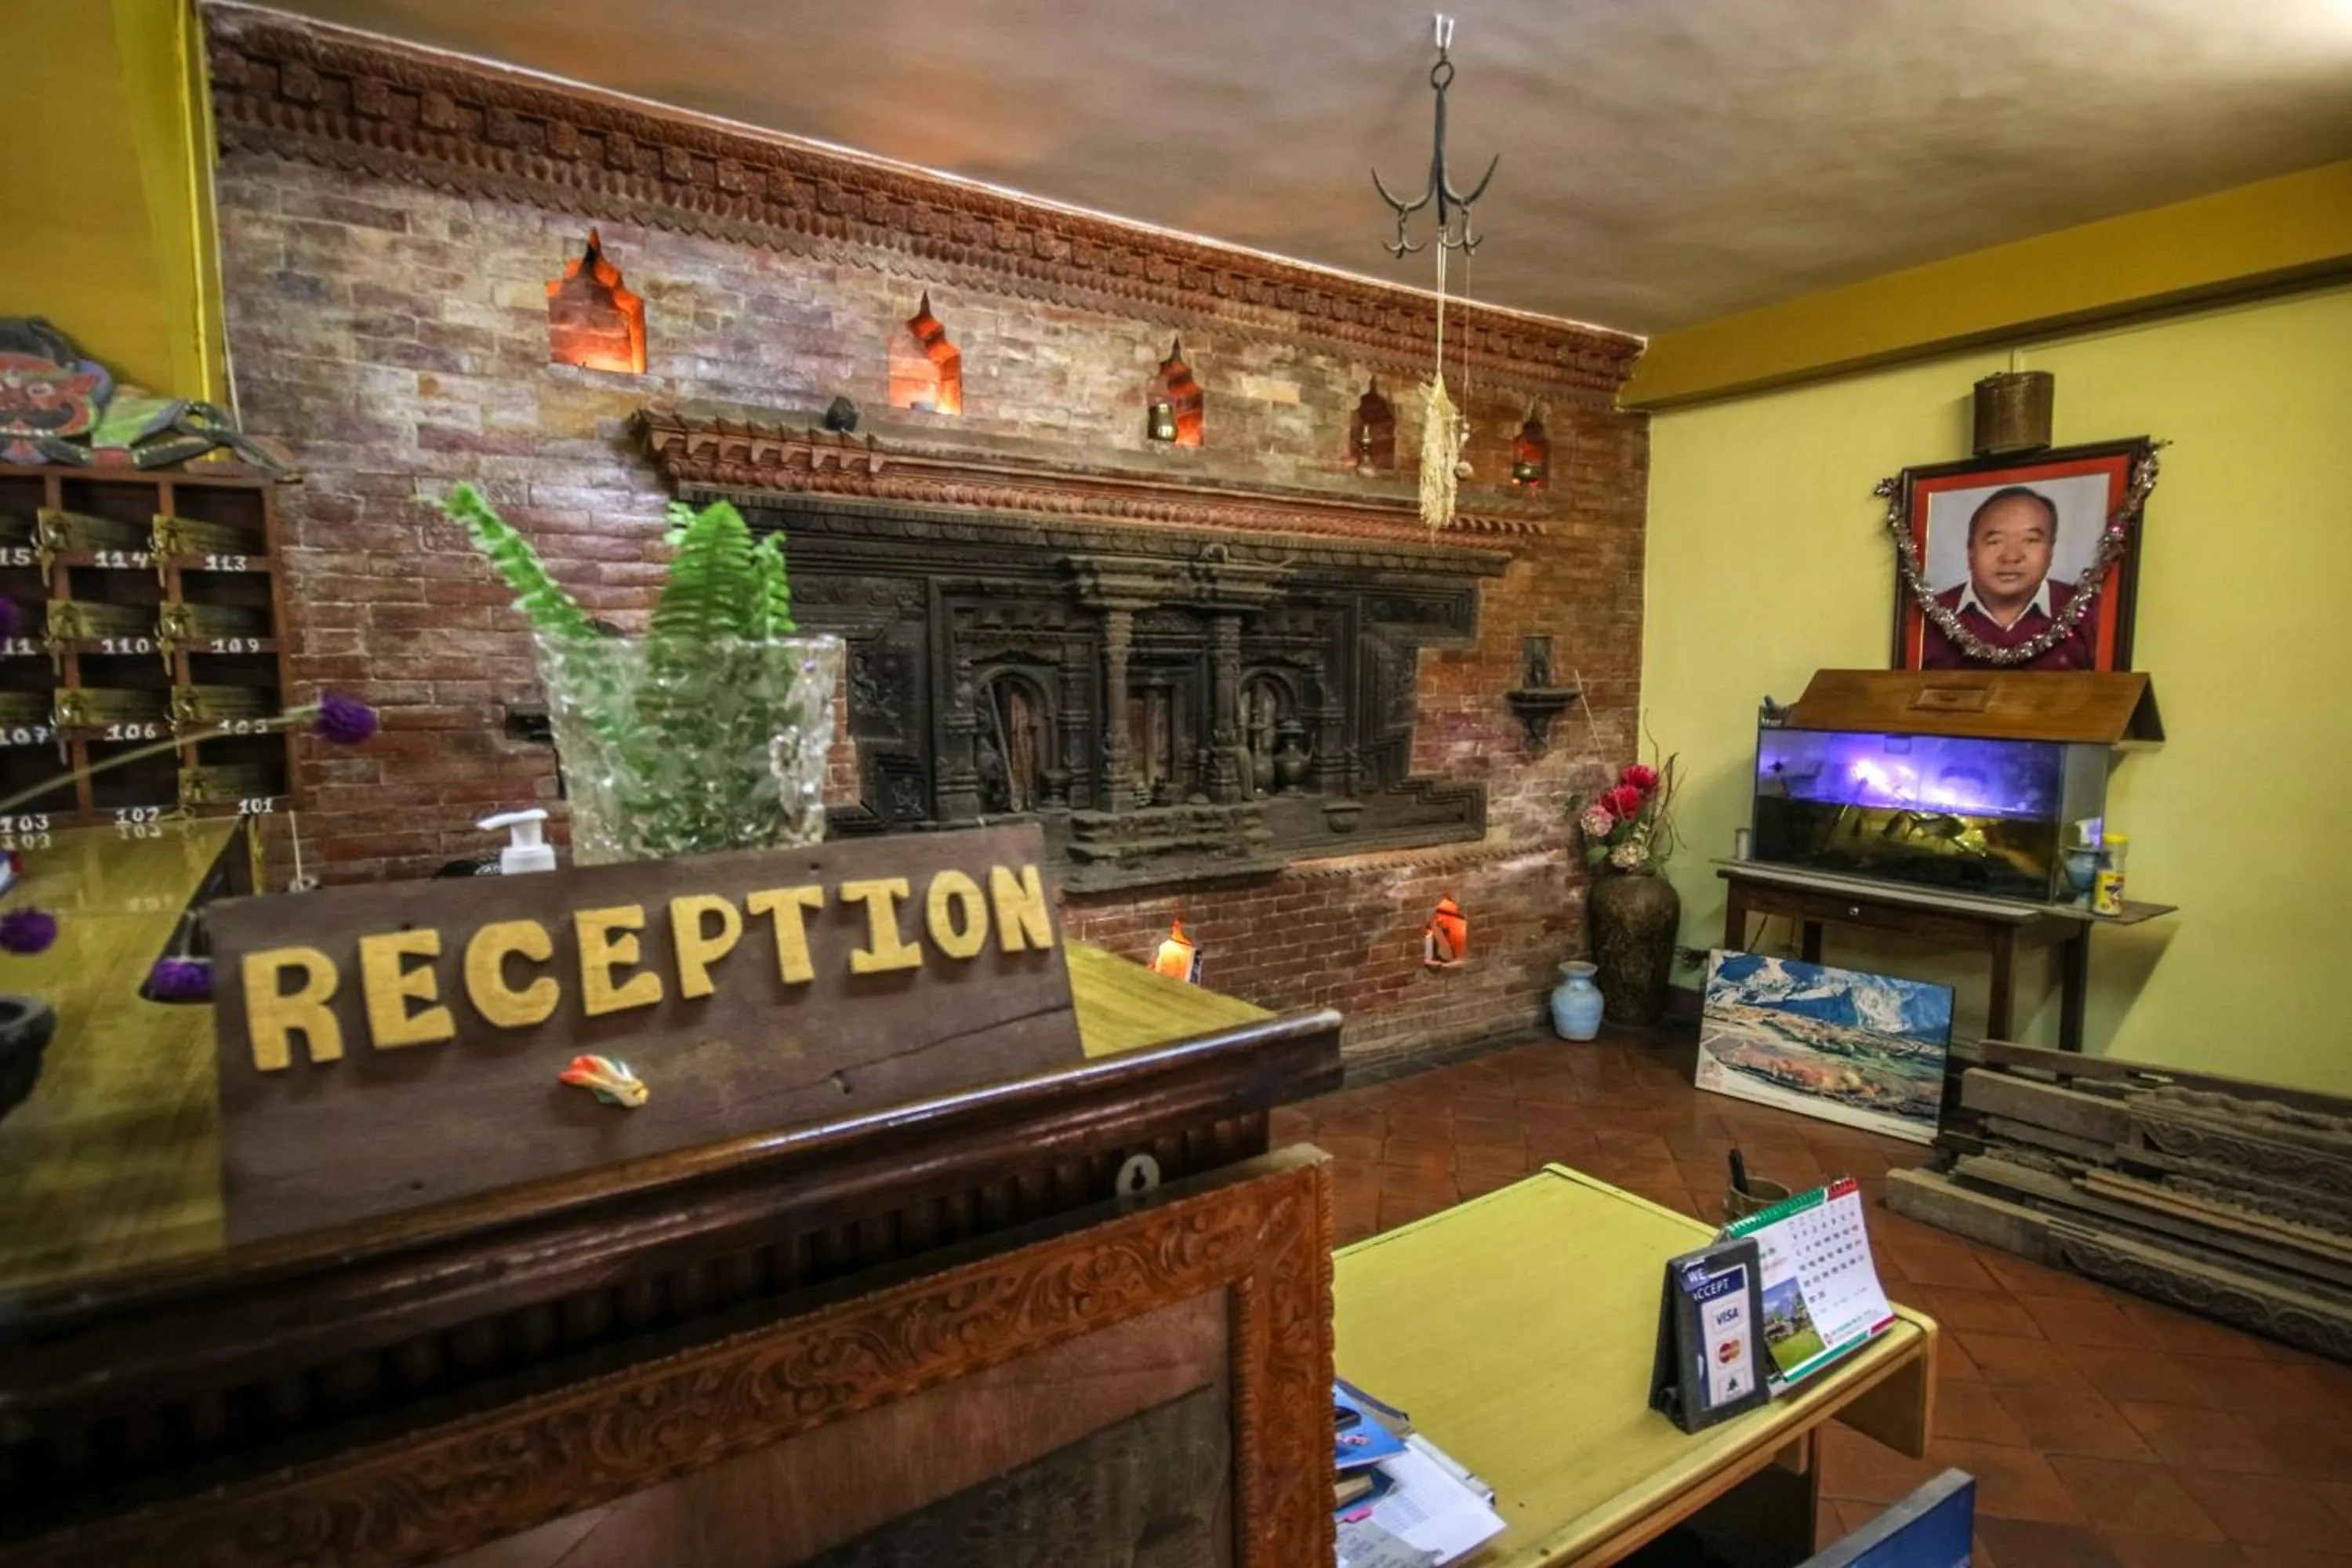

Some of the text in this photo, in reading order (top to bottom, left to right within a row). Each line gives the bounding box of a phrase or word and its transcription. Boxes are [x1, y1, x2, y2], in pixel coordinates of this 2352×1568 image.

[94, 550, 148, 569] 114
[204, 554, 247, 572] 113
[101, 637, 151, 655] 110
[210, 637, 260, 654] 109
[0, 726, 49, 745] 107
[103, 723, 157, 742] 106
[114, 806, 160, 825] 102
[238, 797, 274, 815] 101
[0, 814, 49, 833] 103
[241, 864, 1054, 1072] RECEPTION
[1687, 1268, 1706, 1283] WE
[1716, 1307, 1739, 1326] VISA
